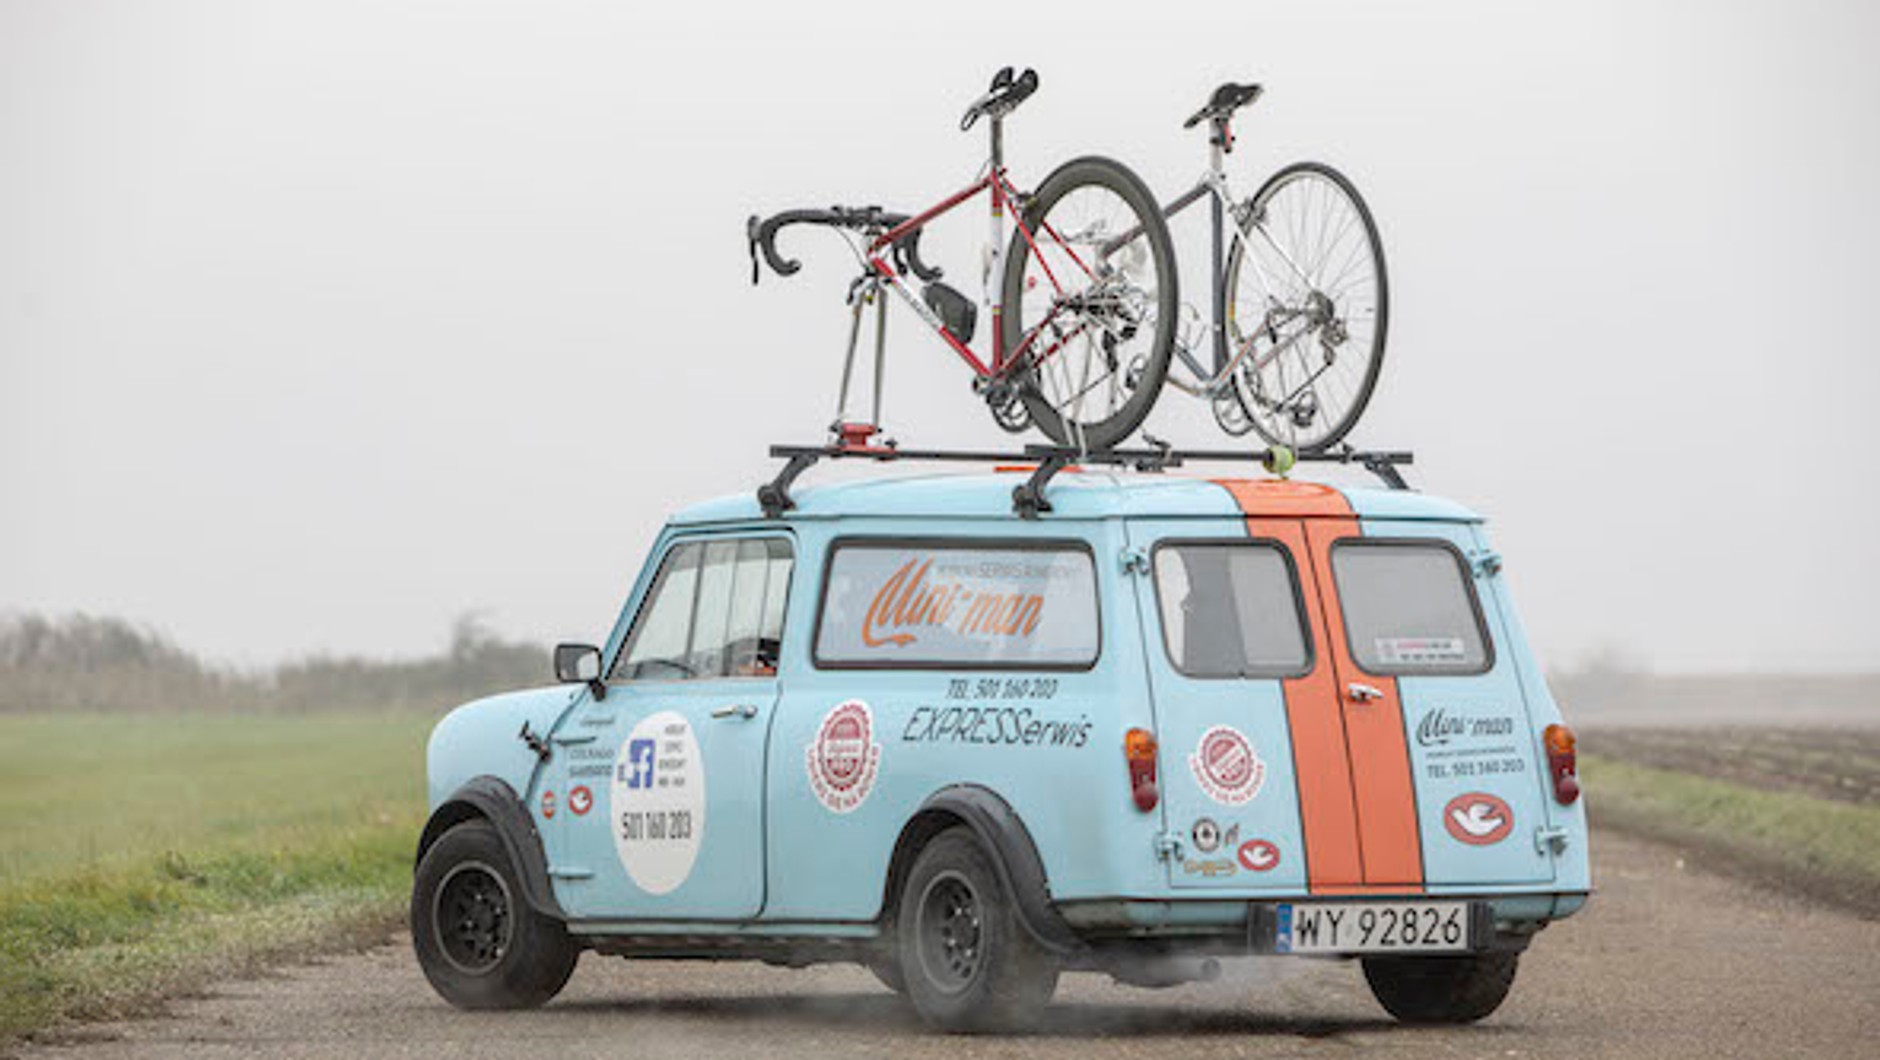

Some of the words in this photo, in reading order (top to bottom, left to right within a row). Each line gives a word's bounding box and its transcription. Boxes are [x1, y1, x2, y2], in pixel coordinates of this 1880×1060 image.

[862, 557, 1044, 647] Mini-man
[973, 678, 1000, 699] 501
[1002, 678, 1029, 699] 160
[1030, 678, 1059, 699] 203
[903, 707, 1093, 748] EXPRESSerwis
[1416, 707, 1513, 747] Mini-man
[1452, 761, 1475, 776] 501
[1478, 760, 1500, 775] 160
[1502, 758, 1525, 773] 203
[622, 811, 643, 840] 501
[645, 811, 666, 840] 160
[669, 810, 692, 840] 203
[1295, 909, 1345, 947] WY
[1358, 907, 1462, 946] 92826
